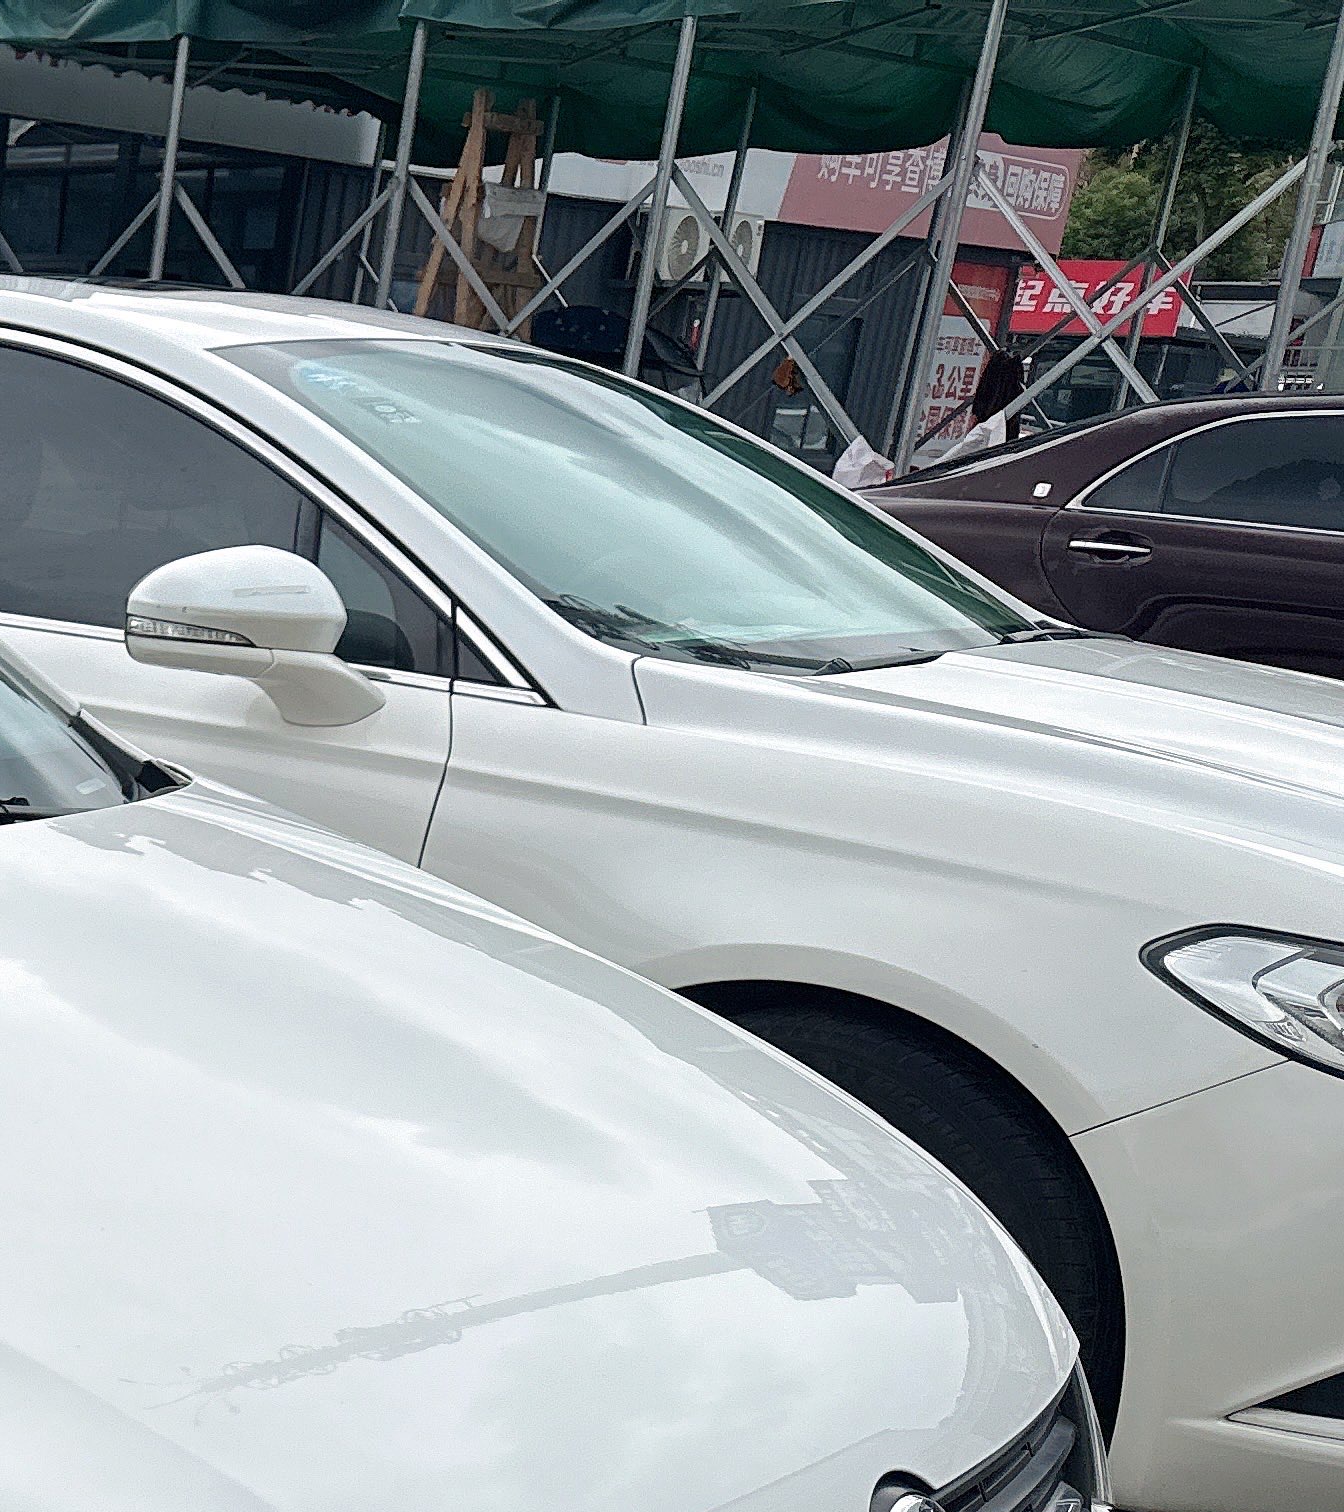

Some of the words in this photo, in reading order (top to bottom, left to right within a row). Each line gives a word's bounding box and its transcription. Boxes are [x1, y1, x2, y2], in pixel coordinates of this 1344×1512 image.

[818, 148, 946, 196] 购车可享查博
